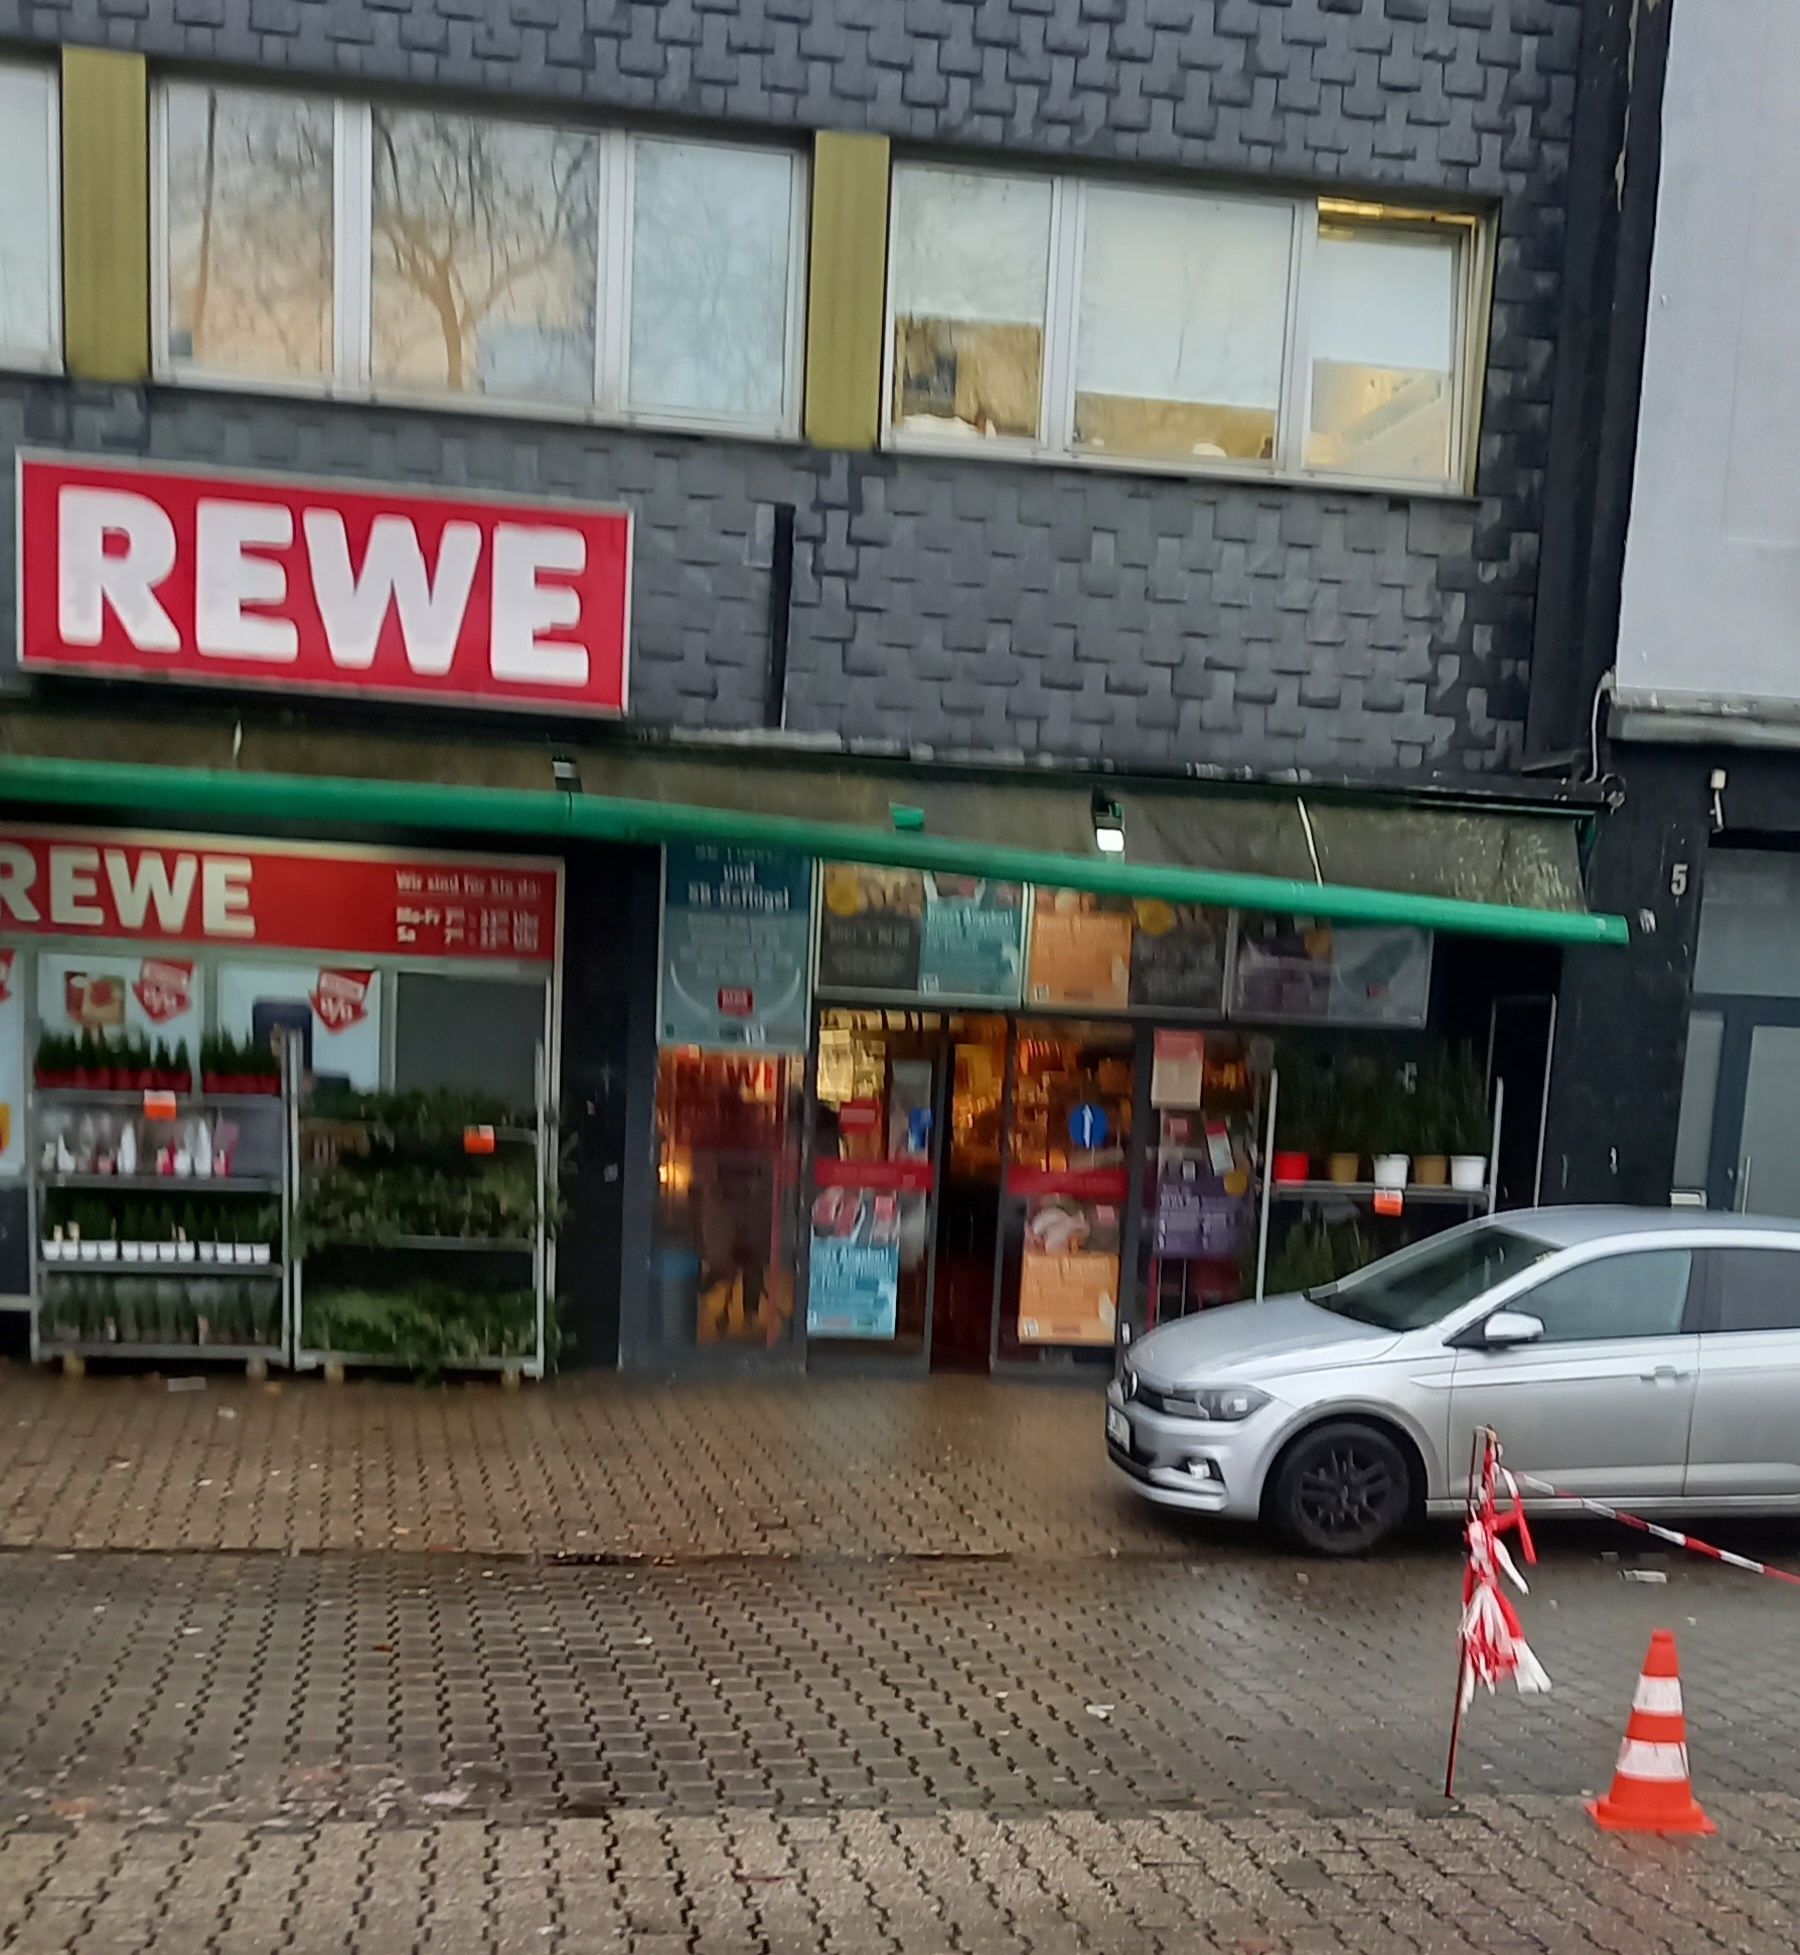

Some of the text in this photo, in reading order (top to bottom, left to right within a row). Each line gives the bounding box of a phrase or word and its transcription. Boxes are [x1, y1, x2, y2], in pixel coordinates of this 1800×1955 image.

[58, 485, 589, 686] REWE
[0, 841, 256, 938] REWE
[396, 870, 423, 891] Wir
[1671, 863, 1689, 896] 5
